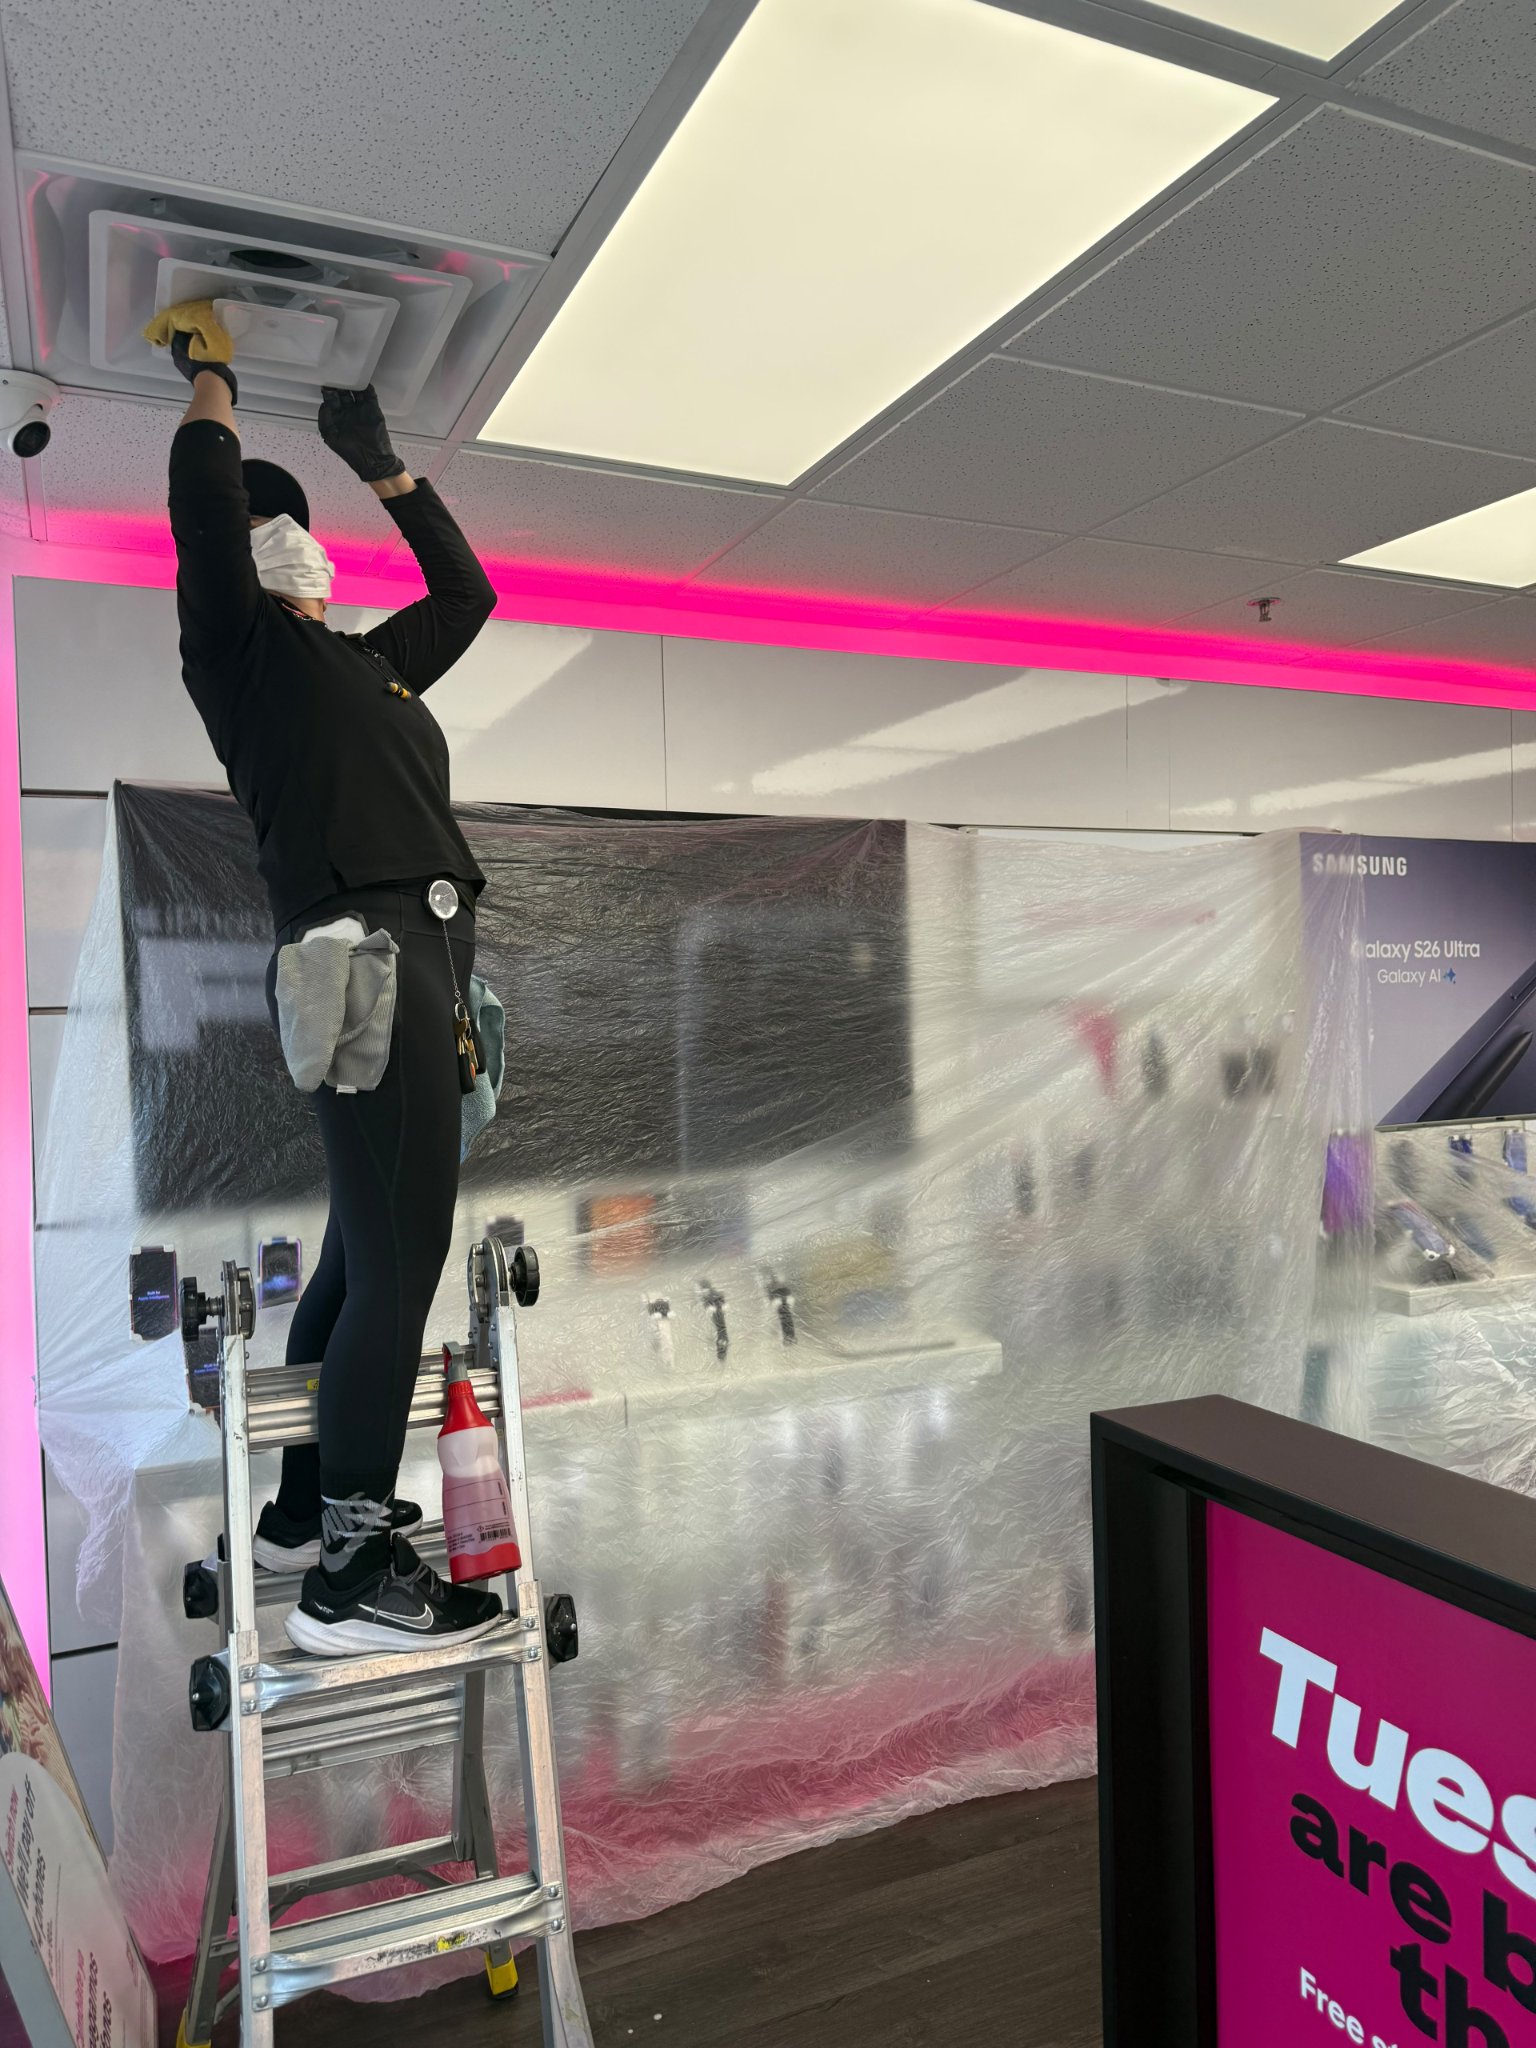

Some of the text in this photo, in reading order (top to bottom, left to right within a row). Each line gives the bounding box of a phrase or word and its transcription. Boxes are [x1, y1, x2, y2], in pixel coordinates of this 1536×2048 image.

[1312, 852, 1407, 876] SAMSUNG
[1351, 940, 1480, 963] alaxy S26 Ultra
[1377, 968, 1441, 988] Galaxy AI
[1290, 1793, 1452, 1945] are
[1300, 1966, 1364, 2045] Free
